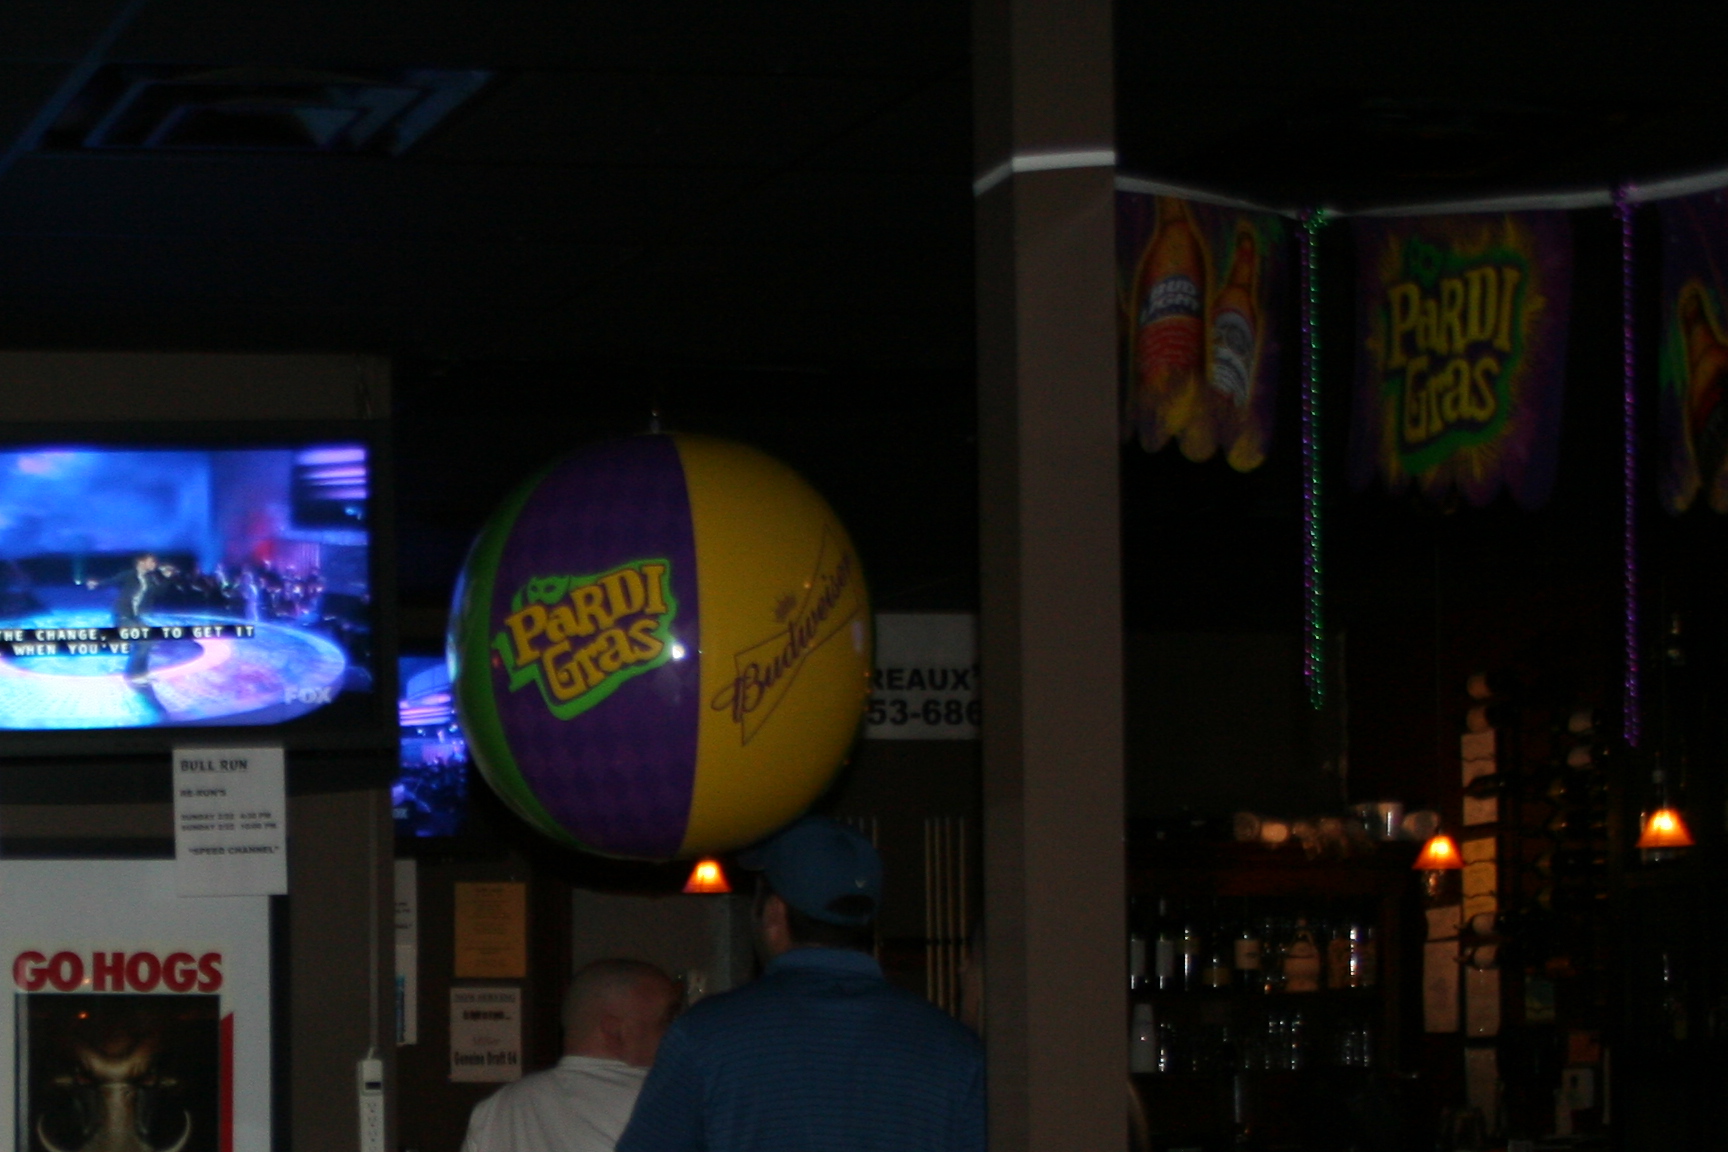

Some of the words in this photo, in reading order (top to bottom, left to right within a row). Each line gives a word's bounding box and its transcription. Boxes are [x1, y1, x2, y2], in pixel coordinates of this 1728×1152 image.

[1401, 355, 1502, 444] Gras
[35, 628, 107, 643] CHANGE,
[119, 627, 151, 640] GOT
[162, 627, 183, 640] TO
[192, 626, 223, 639] GET
[235, 625, 255, 638] IT
[711, 552, 852, 723] Budweiser
[13, 643, 57, 656] WHEN
[68, 643, 131, 656] YOU'VE
[540, 618, 665, 700] Gras
[284, 686, 332, 705] FOX
[180, 760, 214, 772] BULL
[220, 760, 247, 772] RUN
[13, 951, 84, 992] GO
[92, 951, 222, 993] HOGS
